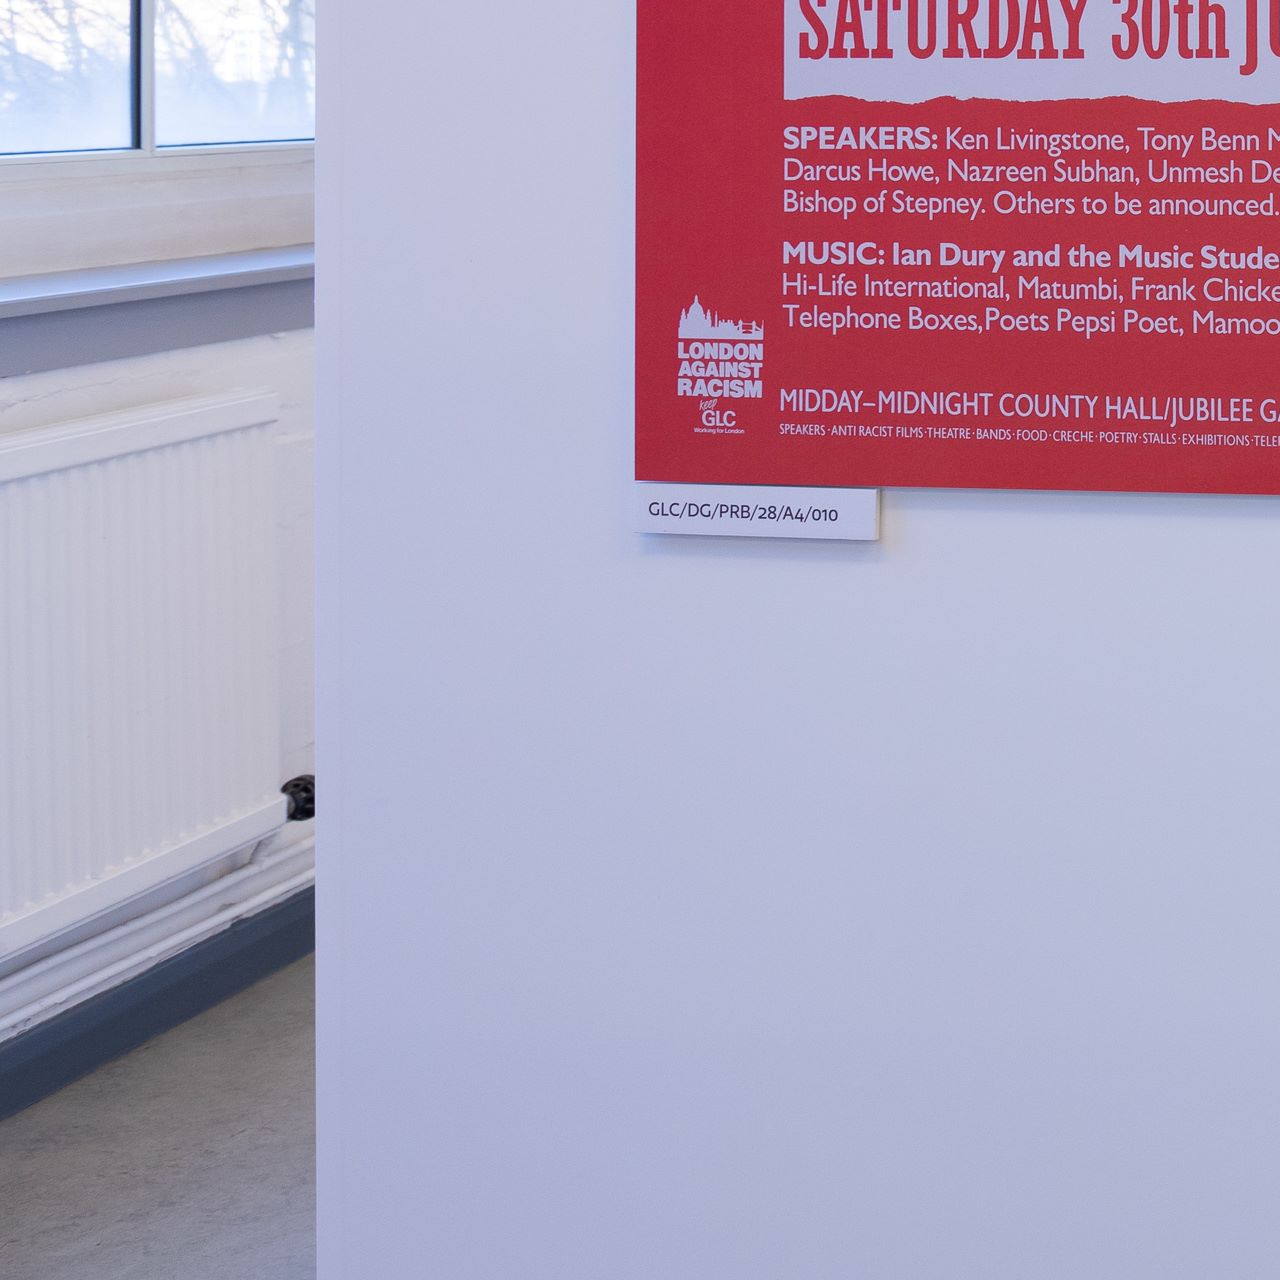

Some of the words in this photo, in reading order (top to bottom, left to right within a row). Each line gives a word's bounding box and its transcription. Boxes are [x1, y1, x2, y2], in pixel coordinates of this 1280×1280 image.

[783, 126, 938, 151] SPEAKERS:
[946, 127, 988, 150] Ken
[997, 127, 1130, 157] Livingstone,
[1137, 127, 1194, 157] Tony
[1201, 128, 1260, 151] Benn
[784, 158, 860, 182] Darcus
[868, 159, 940, 184] Howe,
[948, 159, 1046, 182] Nazreen
[1054, 159, 1140, 185] Subhan,
[1147, 160, 1243, 184] Unmesh
[784, 190, 856, 220] Bishop
[863, 190, 887, 213] of
[892, 190, 986, 221] Stepney.
[994, 190, 1074, 215] Others
[1082, 195, 1107, 215] to
[1115, 191, 1141, 215] be
[1148, 193, 1280, 217] announced.
[783, 242, 885, 265] MUSIC:
[893, 242, 931, 266] Ian
[939, 243, 1005, 273] Dury
[1012, 244, 1060, 267] and
[1068, 245, 1111, 267] the
[1119, 245, 1193, 269] Music
[782, 273, 856, 297] Hi-Life
[864, 274, 1010, 301] International,
[1018, 275, 1124, 303] Matumbi,
[1131, 277, 1196, 302] Frank
[782, 304, 900, 335] Telephone
[1057, 308, 1116, 339] Pepsi
[1124, 309, 1184, 337] Poet,
[678, 341, 763, 360] LONDON
[678, 360, 763, 378] AGAINST
[677, 378, 763, 398] RACISM
[699, 399, 718, 412] keep
[999, 393, 1098, 418] COUNTY
[1106, 396, 1253, 428] HALL/JUBILEE
[702, 410, 737, 427] GLC
[779, 423, 825, 436] SPEAKERS
[858, 425, 893, 438] RACIST
[648, 501, 839, 522] GLC/DG/PRB/28/A4/010
